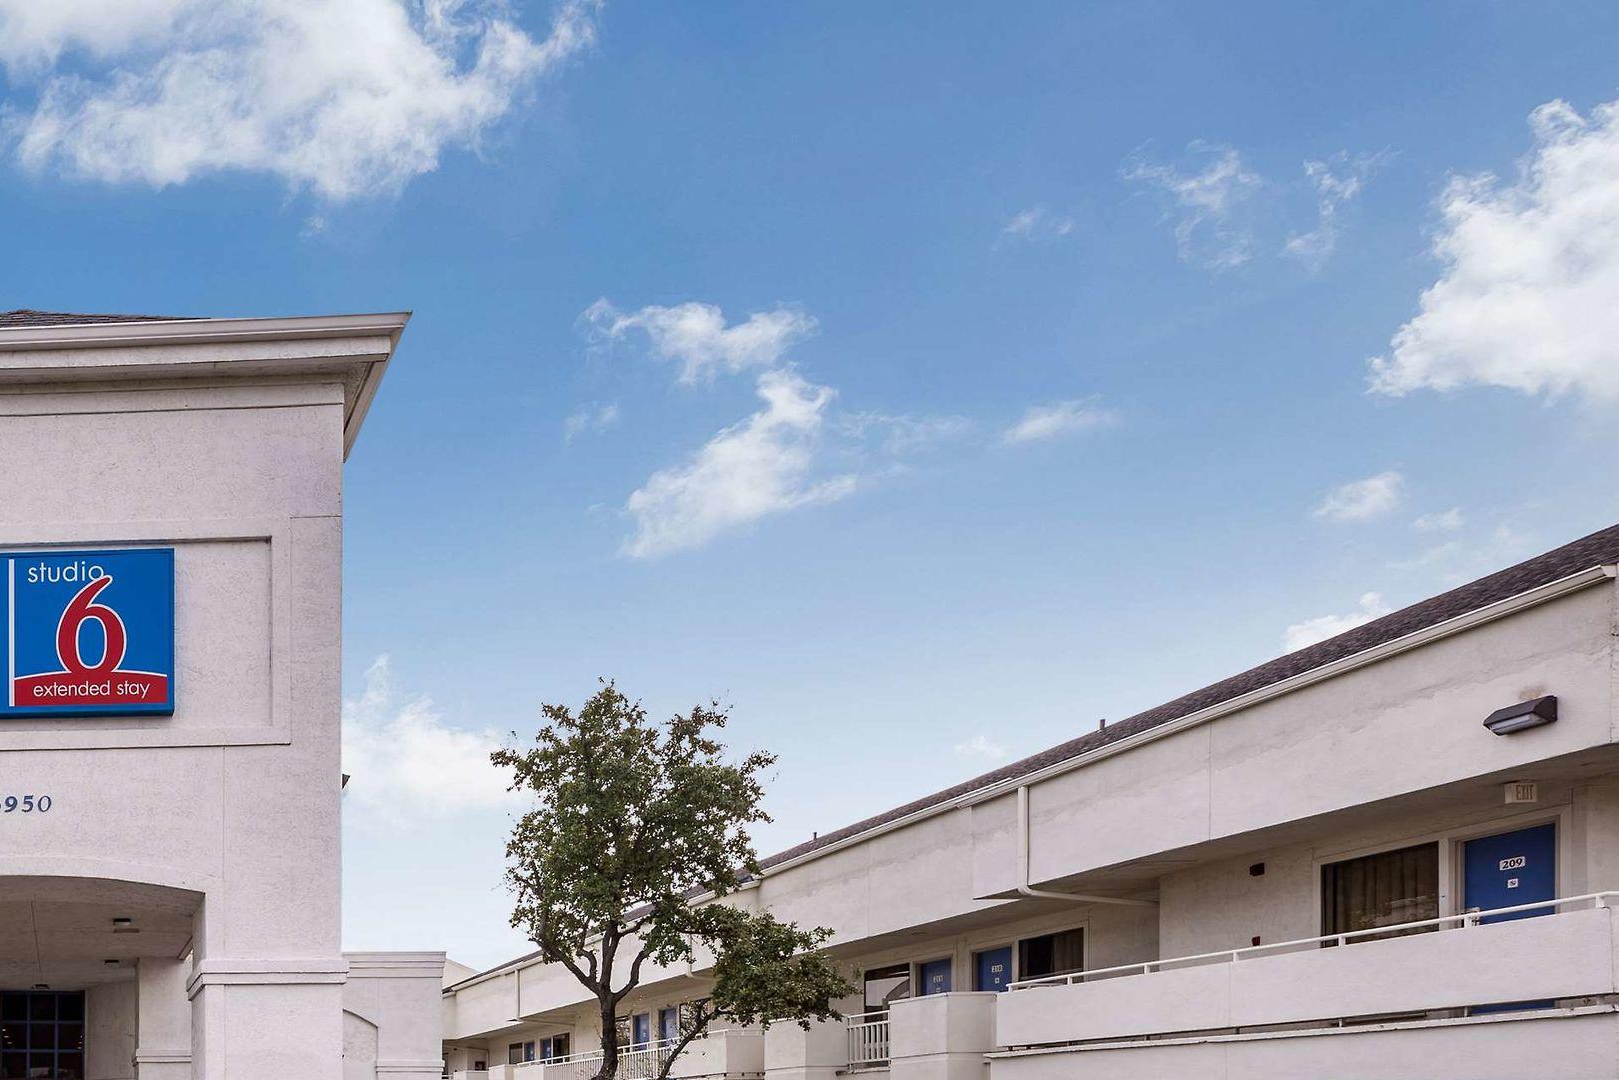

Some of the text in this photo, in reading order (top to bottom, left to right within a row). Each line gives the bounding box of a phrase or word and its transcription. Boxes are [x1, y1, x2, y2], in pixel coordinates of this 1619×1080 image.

[27, 560, 105, 583] studio
[55, 574, 127, 675] 6
[33, 680, 151, 699] extended stay
[1515, 784, 1534, 800] EXIT
[1502, 858, 1523, 869] 209
